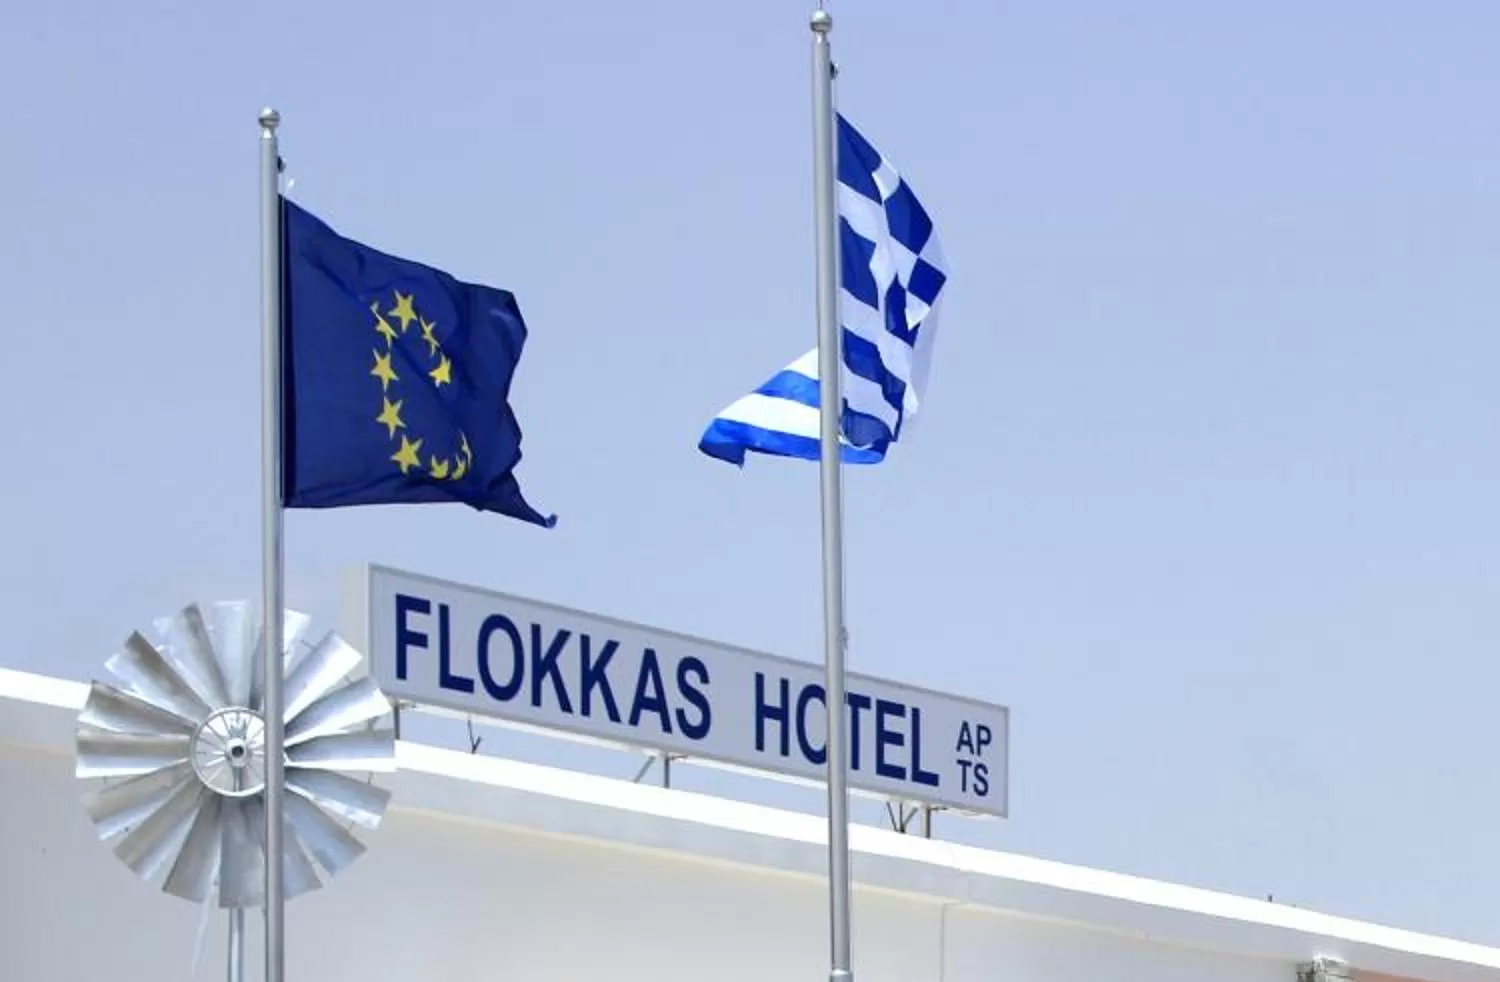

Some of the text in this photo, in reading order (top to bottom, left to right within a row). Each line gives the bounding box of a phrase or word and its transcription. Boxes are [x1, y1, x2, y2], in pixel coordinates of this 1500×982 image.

[394, 592, 940, 788] FLOKKAS HOTEL
[955, 720, 993, 757] AP
[955, 758, 989, 797] TS
